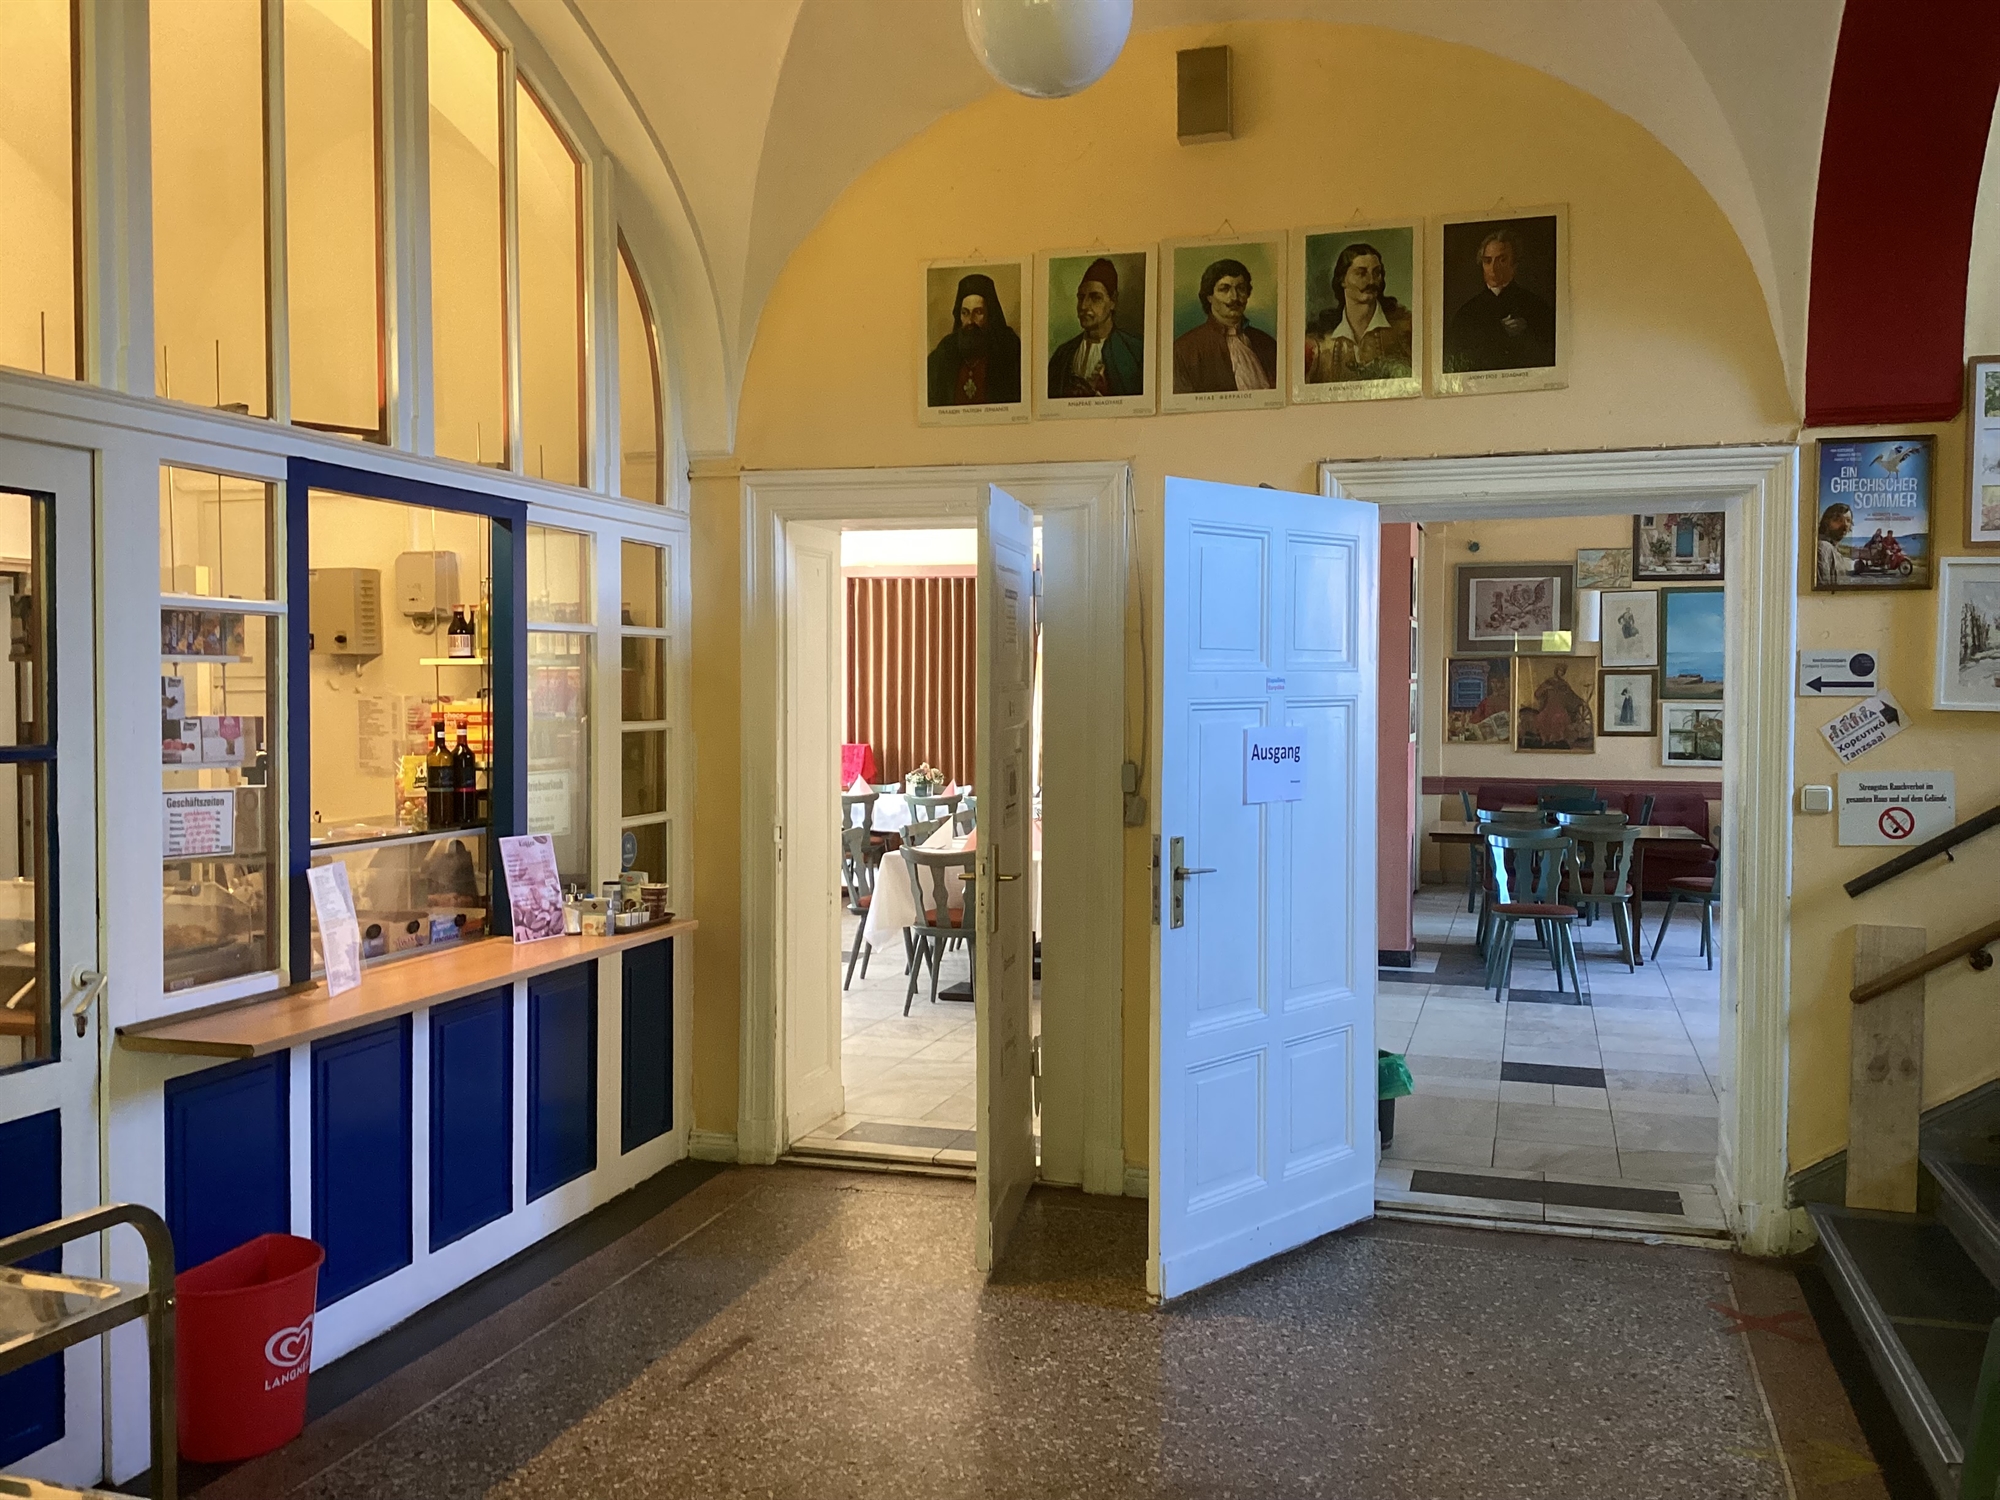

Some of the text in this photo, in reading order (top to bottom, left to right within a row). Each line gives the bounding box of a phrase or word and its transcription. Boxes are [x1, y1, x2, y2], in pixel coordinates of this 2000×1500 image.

[1840, 466, 1857, 478] EIN
[1830, 477, 1918, 493] GRIECHISCHER
[1854, 492, 1917, 509] SOMMER
[1843, 732, 1886, 761] Tanzsaal
[1251, 744, 1301, 764] Ausgang
[1859, 783, 1888, 791] Strengstes
[1890, 782, 1925, 790] Rauchverbot
[166, 797, 225, 808] Geschäftszeiten
[1924, 794, 1947, 802] Gelände
